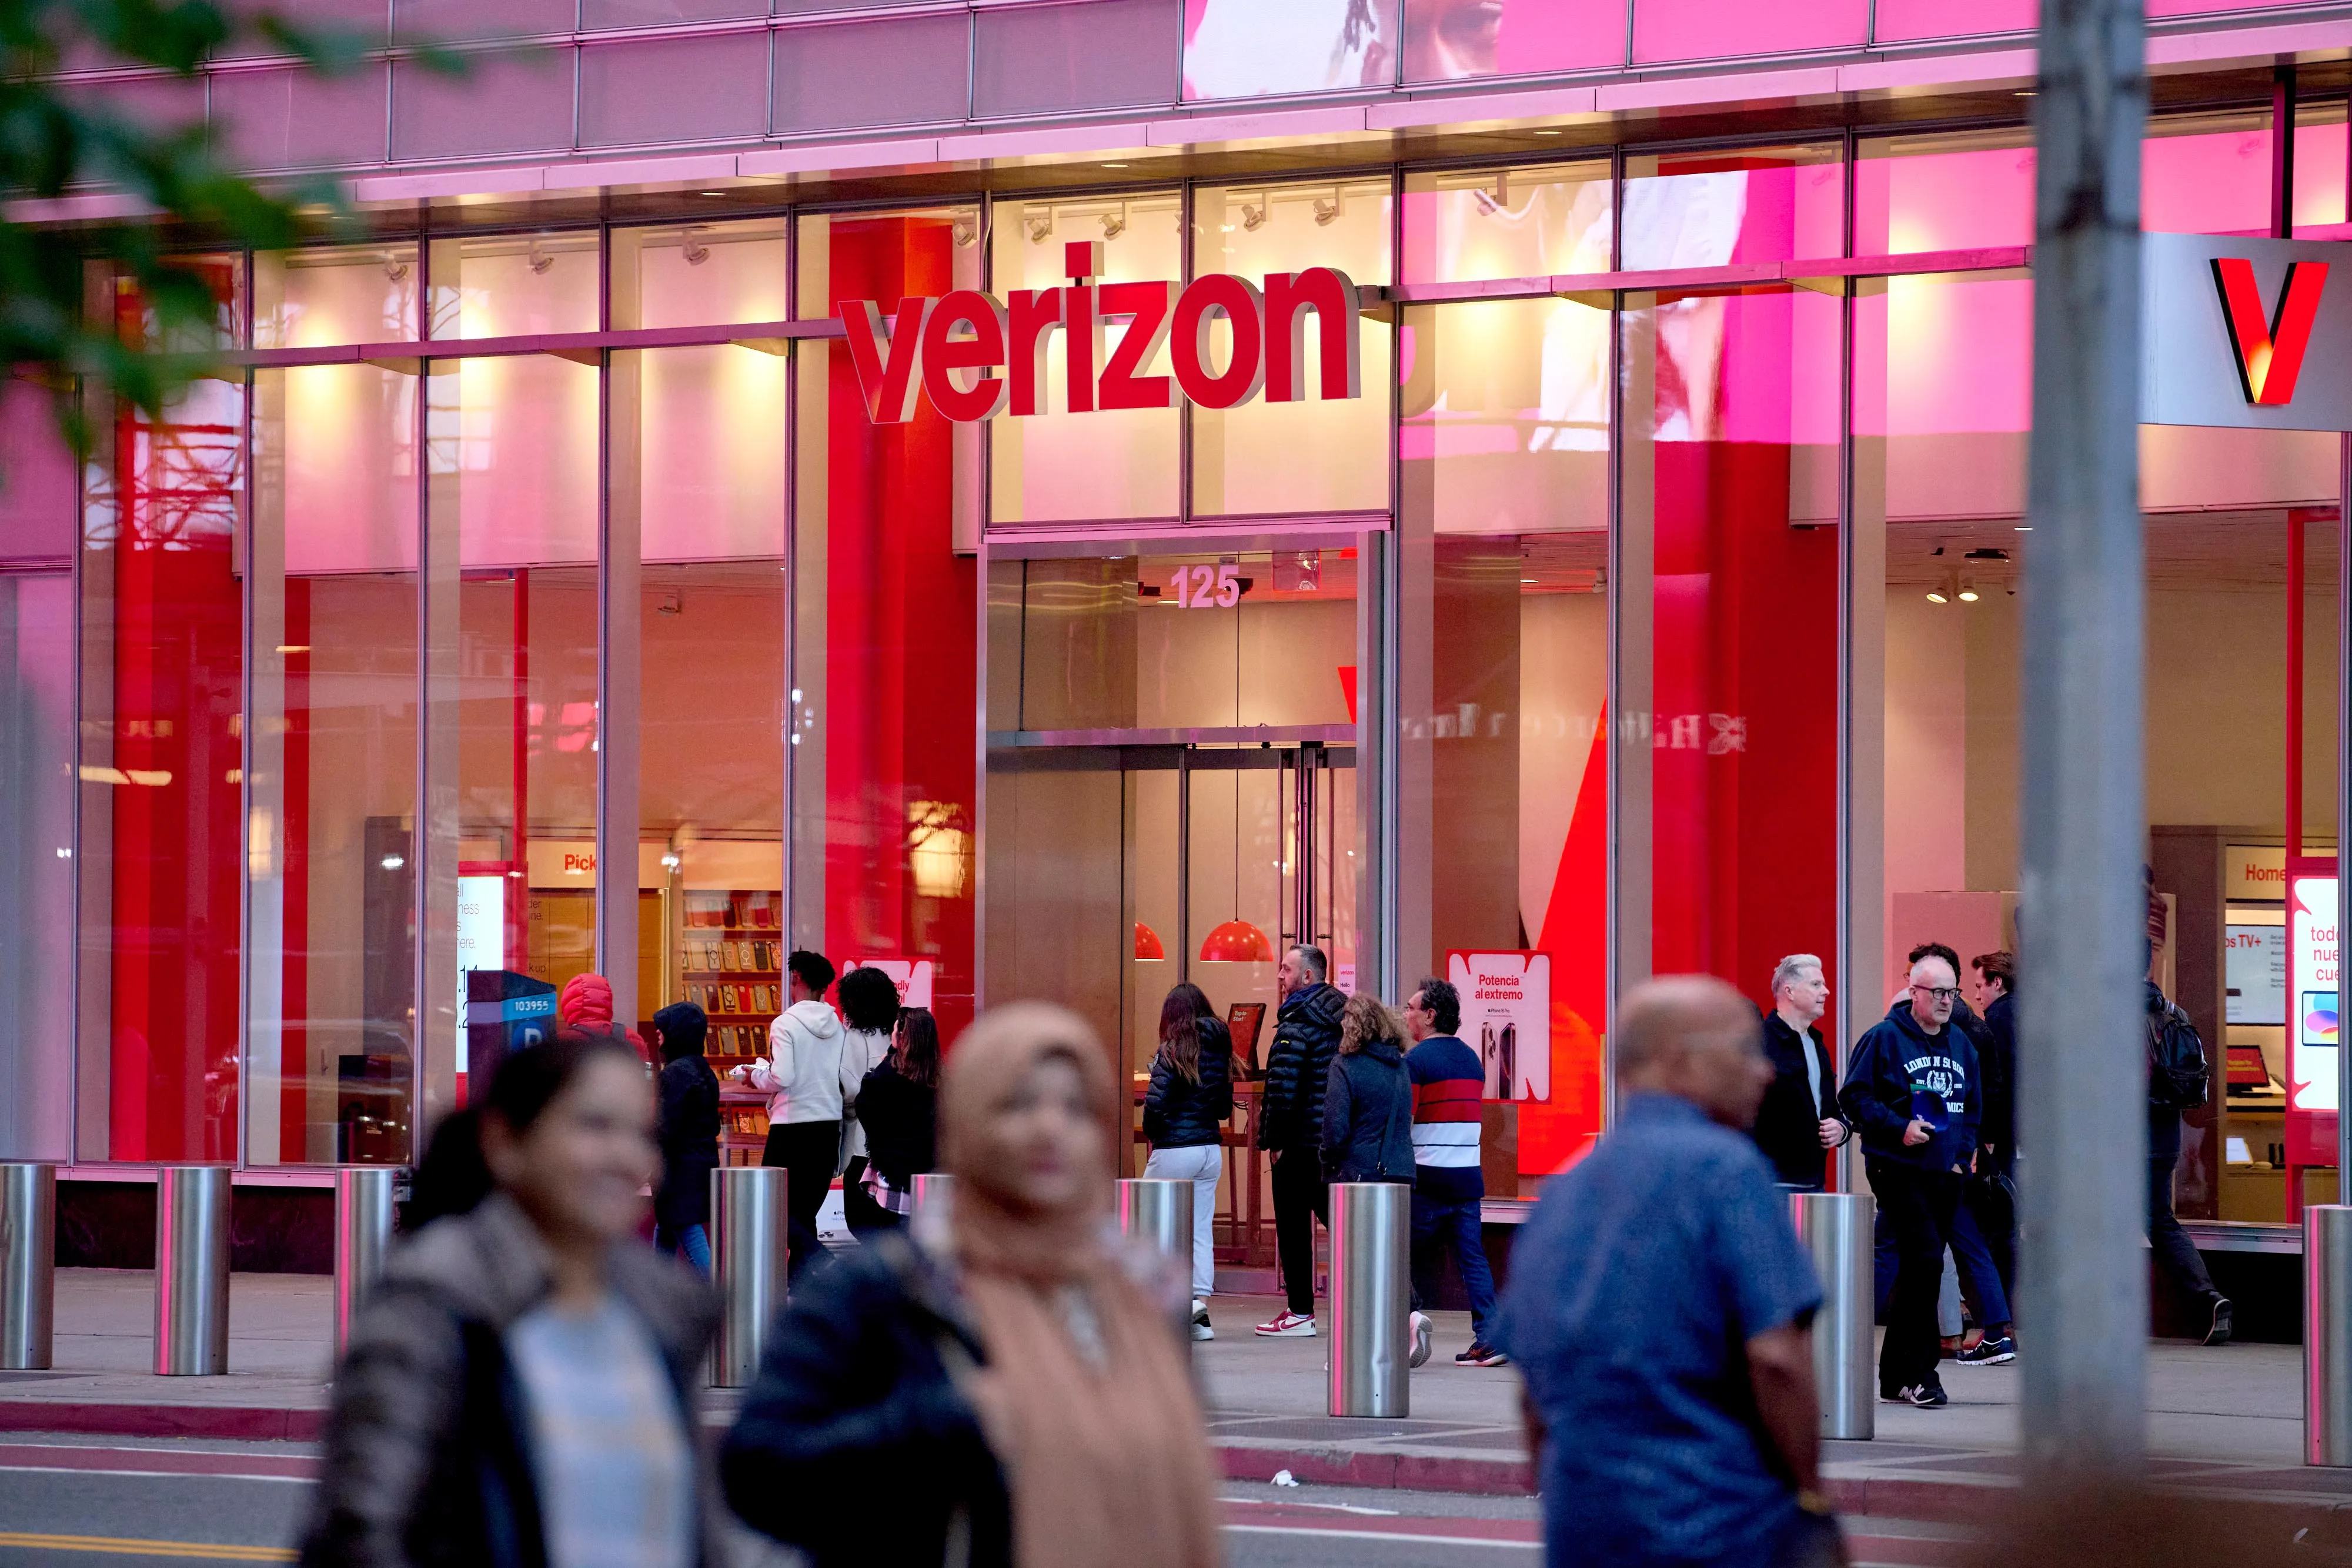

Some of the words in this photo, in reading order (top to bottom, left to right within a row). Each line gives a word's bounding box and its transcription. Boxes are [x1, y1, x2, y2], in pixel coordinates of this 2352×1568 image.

[838, 240, 1361, 424] verizon
[1171, 564, 1240, 609] 125
[2246, 864, 2286, 881] Home
[2238, 934, 2261, 948] TV+
[2311, 925, 2338, 942] tod
[1479, 974, 1519, 986] Potencia
[1475, 988, 1483, 999] al
[1485, 989, 1523, 1000] extremo
[514, 1001, 549, 1011] 103955
[1904, 1056, 1940, 1074] LONDN
